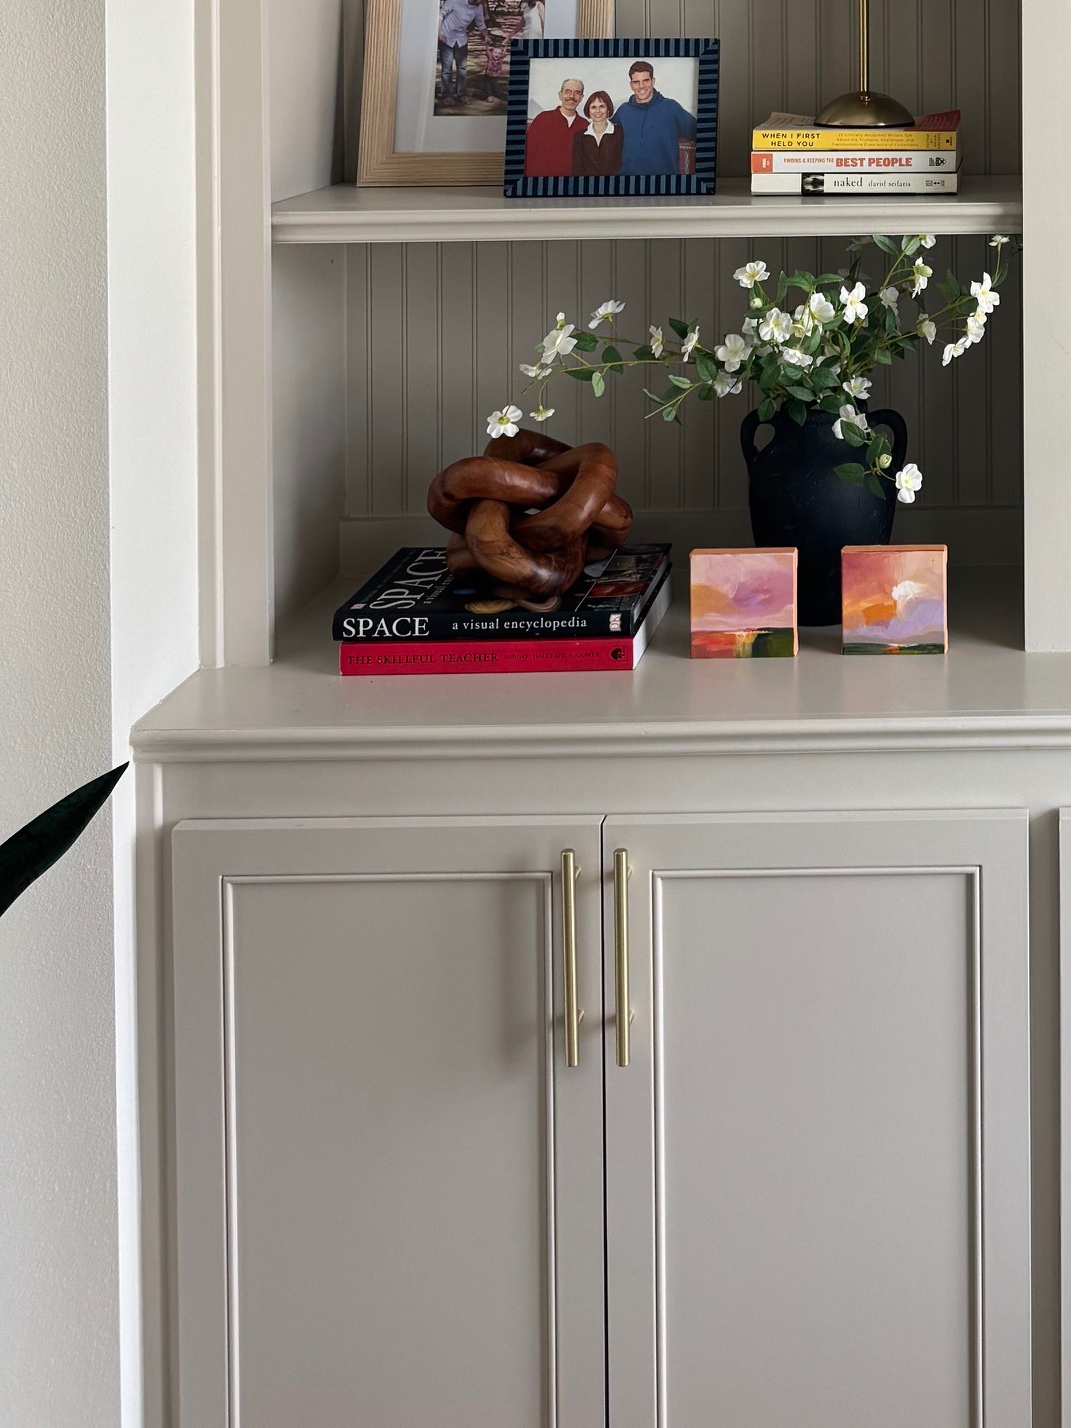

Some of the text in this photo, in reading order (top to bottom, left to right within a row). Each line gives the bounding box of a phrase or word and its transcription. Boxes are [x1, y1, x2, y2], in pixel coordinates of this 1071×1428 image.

[836, 158, 866, 167] BEST
[868, 157, 912, 167] PEOPLE
[834, 177, 863, 187] naked
[343, 617, 587, 638] SPACE a visual encyclopedia
[609, 613, 622, 632] DK
[347, 653, 499, 665] THE SKILLFUL TEACHER
